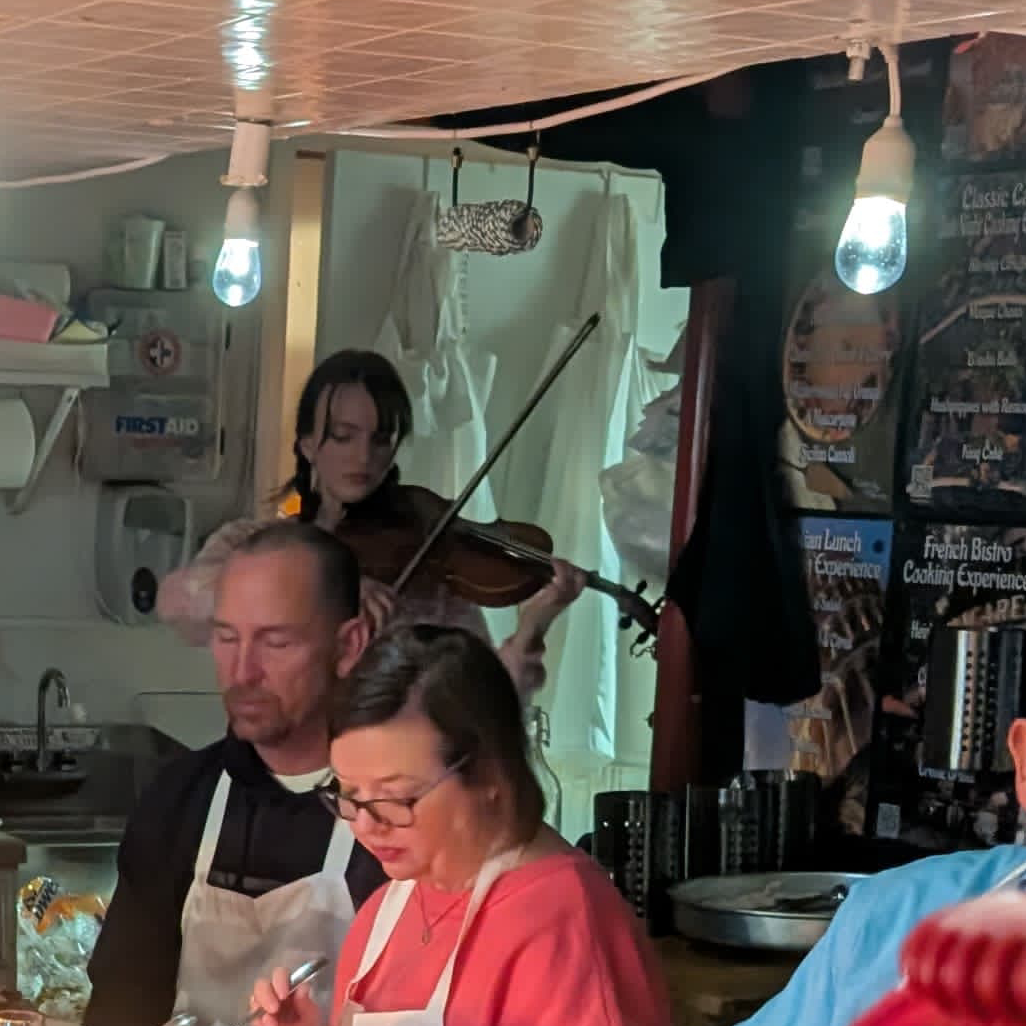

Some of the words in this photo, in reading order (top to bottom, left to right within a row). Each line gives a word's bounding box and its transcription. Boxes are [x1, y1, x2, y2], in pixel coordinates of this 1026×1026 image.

[115, 416, 167, 435] FIRST
[167, 417, 199, 435] AID
[825, 528, 861, 553] Lunch
[923, 536, 968, 563] French
[972, 537, 1012, 563] Bistro
[815, 553, 881, 583] Experience
[903, 559, 954, 592] Cooking
[957, 563, 1026, 595] Experience
